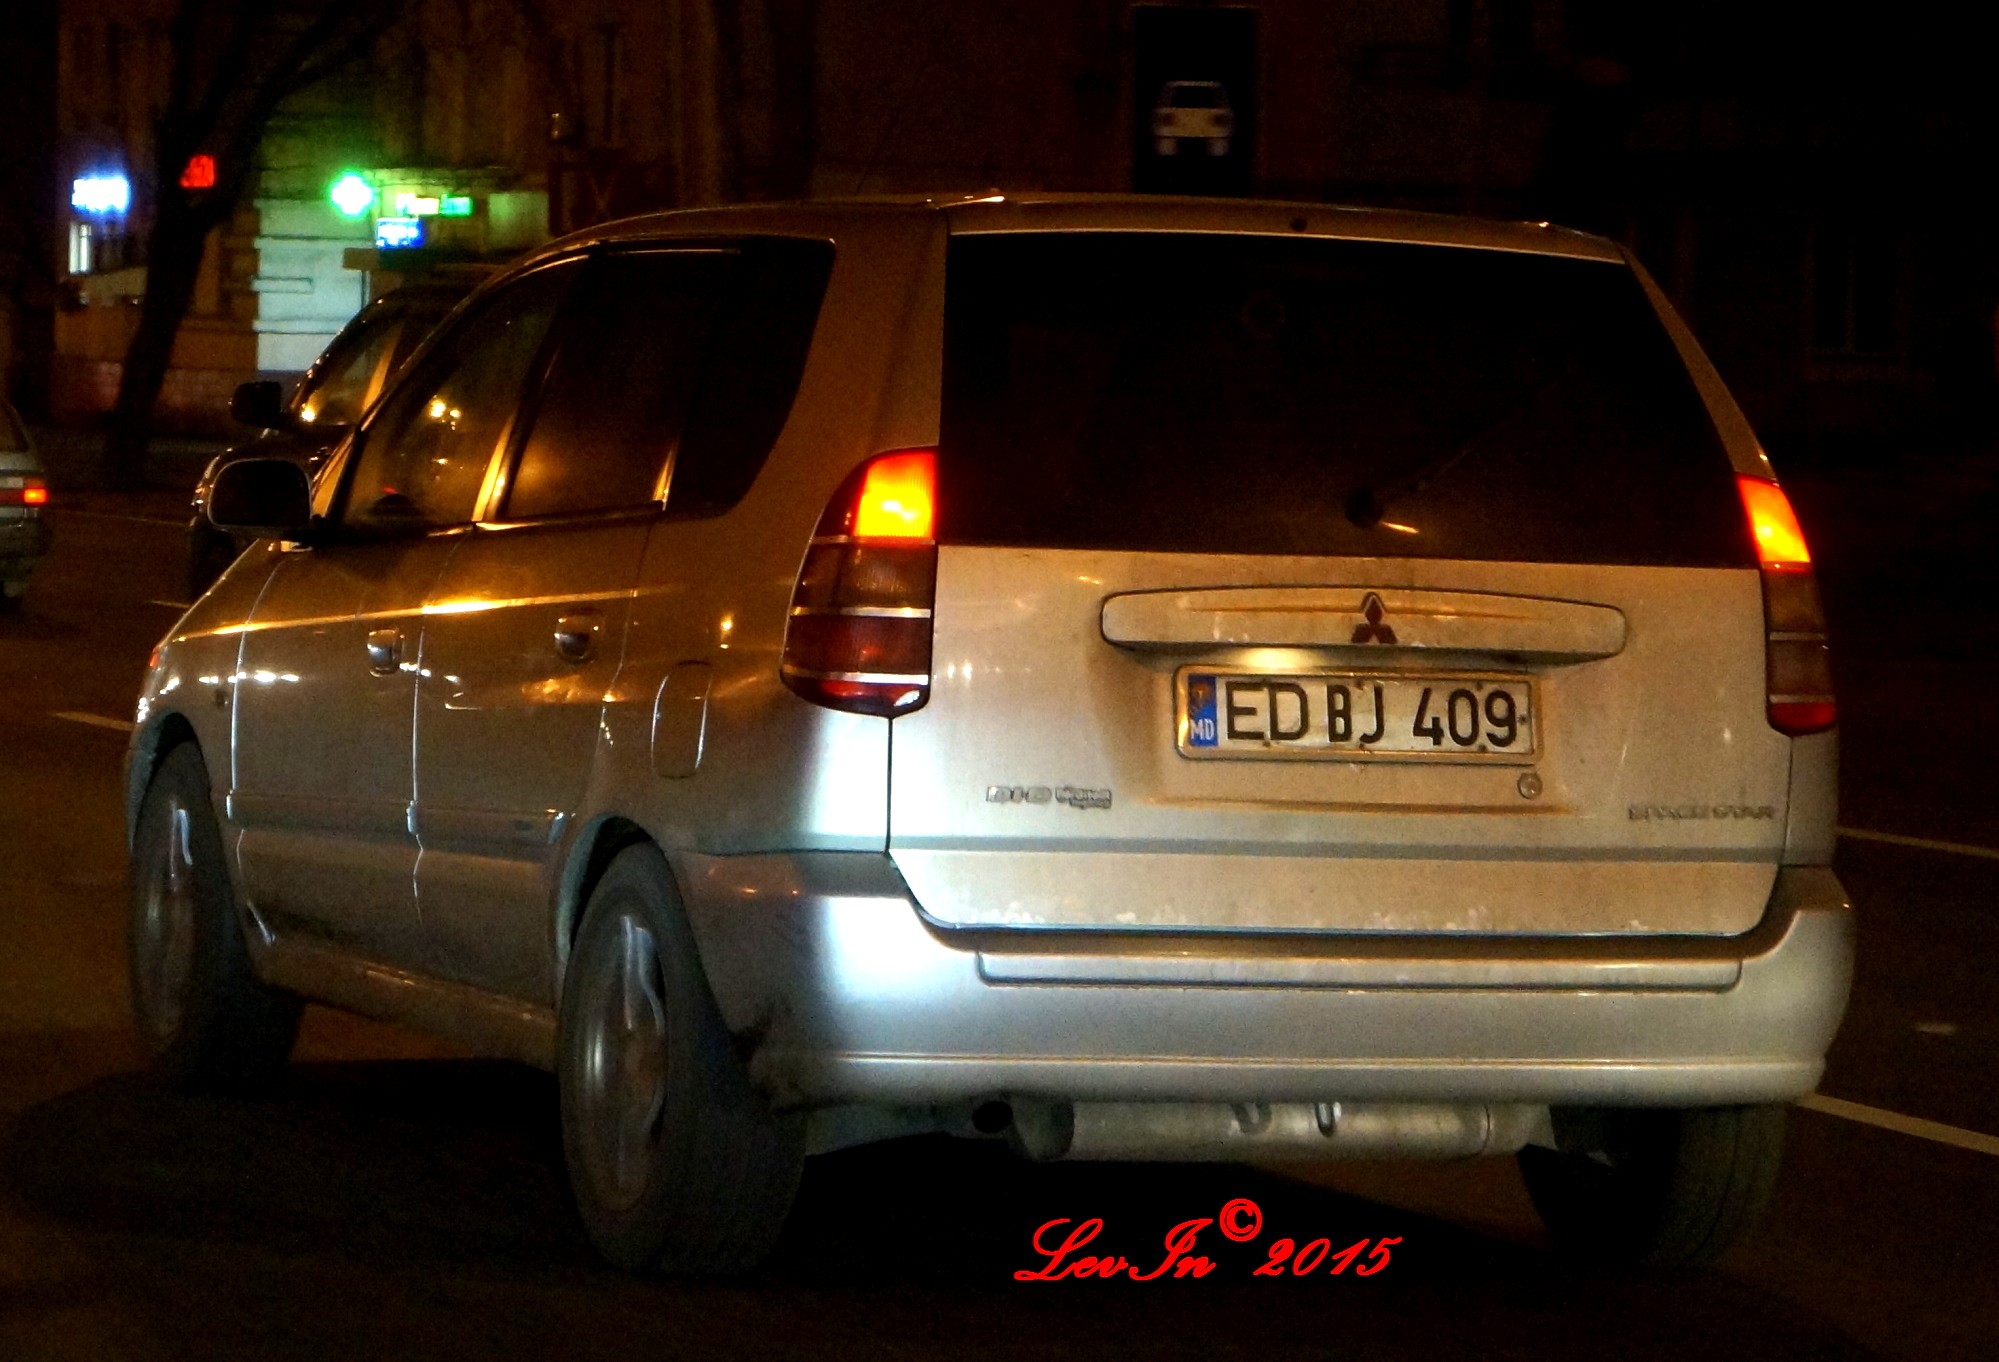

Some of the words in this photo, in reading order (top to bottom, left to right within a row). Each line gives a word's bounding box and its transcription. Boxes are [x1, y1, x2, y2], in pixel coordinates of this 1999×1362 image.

[1190, 719, 1215, 739] MD
[1225, 680, 1308, 741] ED
[1326, 684, 1385, 744] BJ
[1412, 687, 1517, 748] 409
